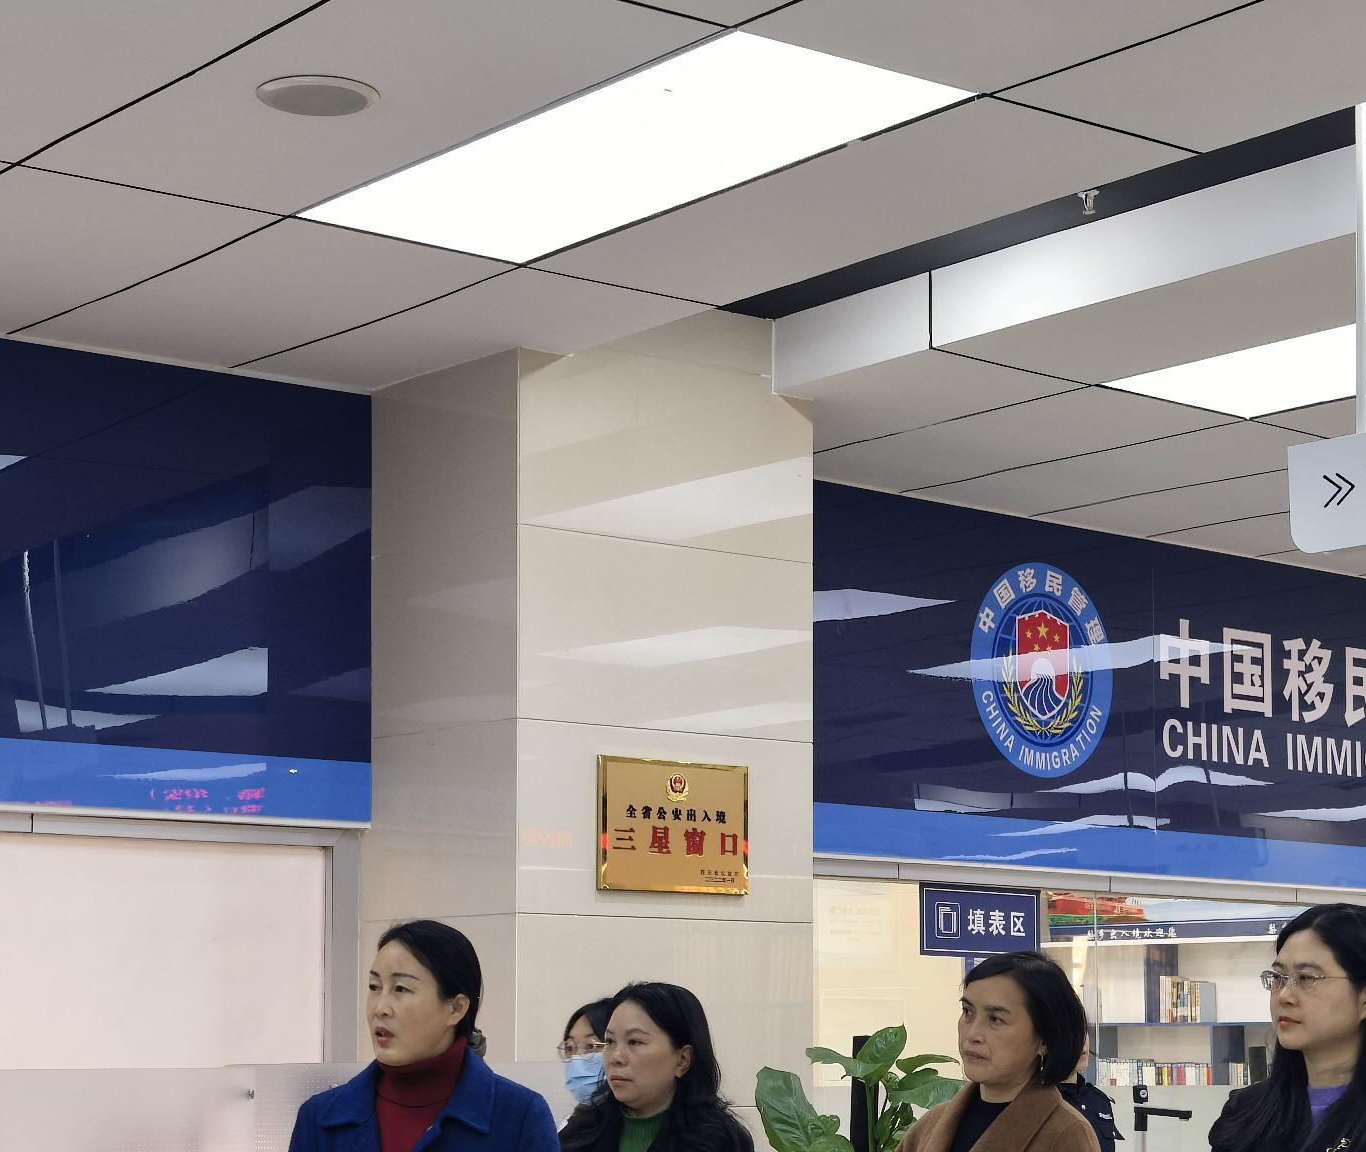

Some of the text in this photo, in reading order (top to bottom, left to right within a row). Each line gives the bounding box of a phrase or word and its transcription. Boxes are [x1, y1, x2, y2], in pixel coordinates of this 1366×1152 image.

[978, 567, 1106, 645] 中国移民管理
[982, 690, 1103, 771] CHINA IMMIGRATION
[1162, 718, 1270, 768] CHINA
[625, 804, 727, 824] 全省公安出入境
[612, 825, 739, 857] 三星窗口
[967, 908, 1026, 937] 填表区
